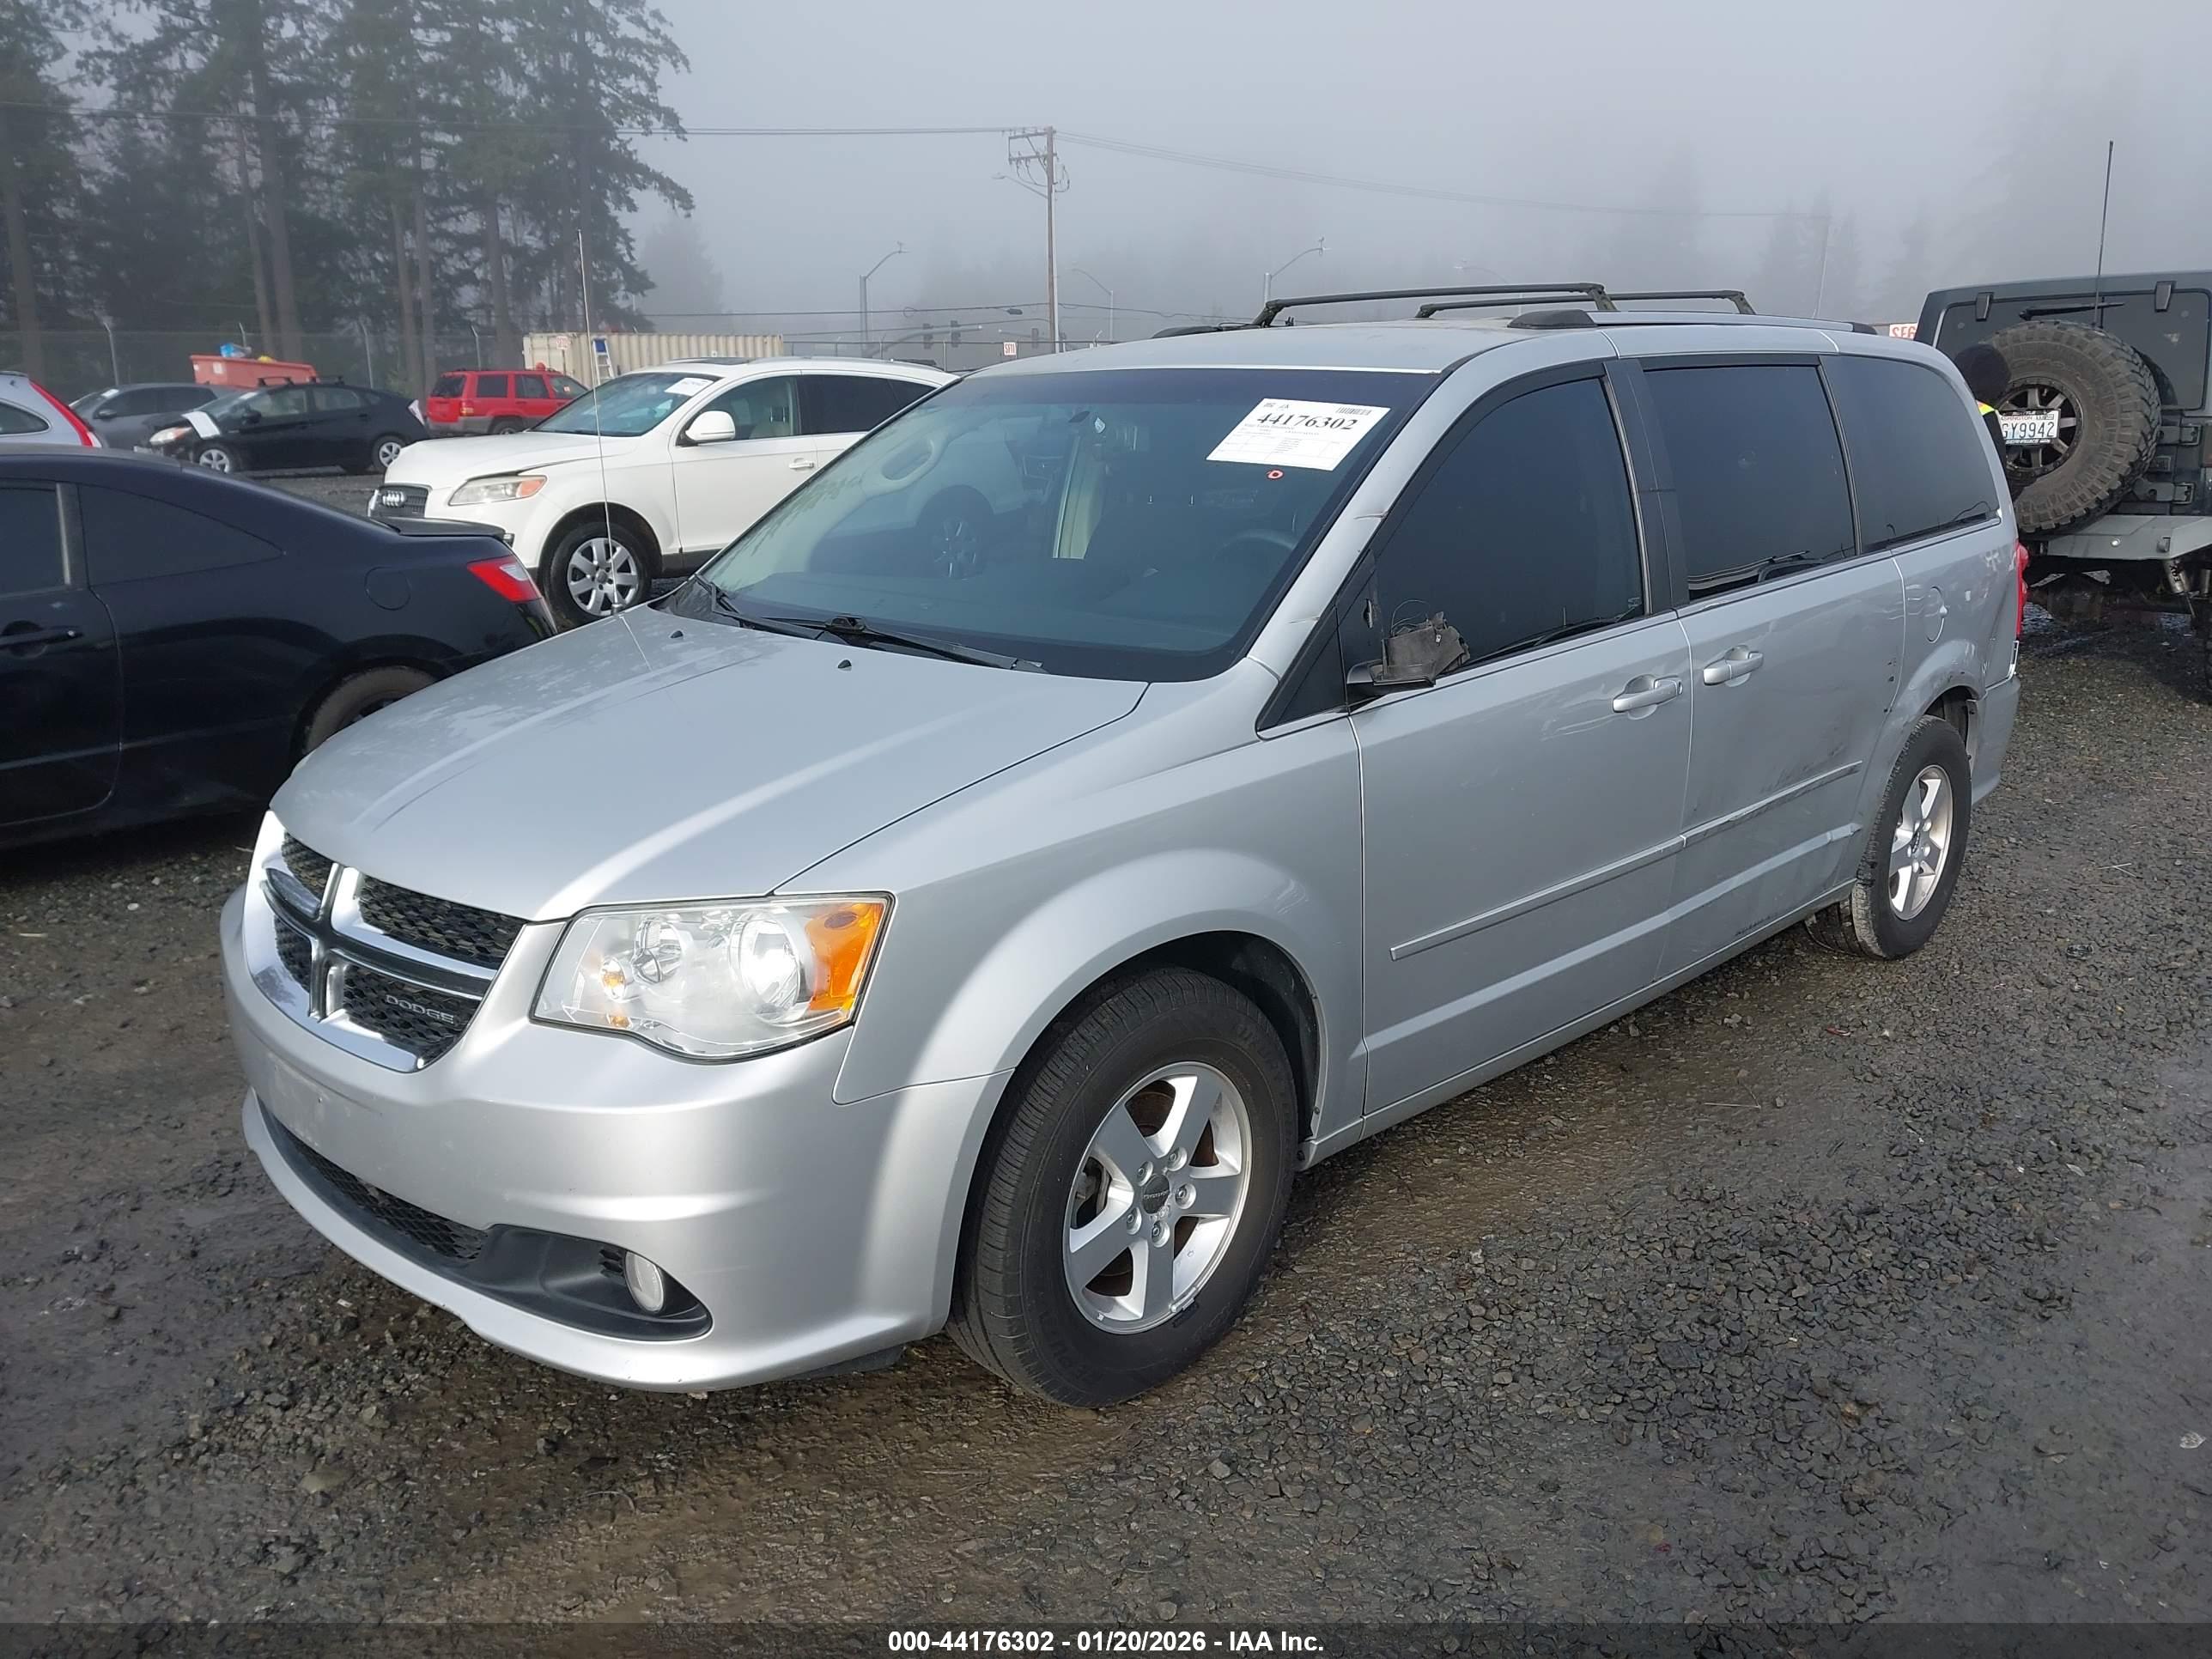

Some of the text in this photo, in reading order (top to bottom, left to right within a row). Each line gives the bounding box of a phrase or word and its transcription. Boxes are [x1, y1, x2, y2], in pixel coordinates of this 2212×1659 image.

[1257, 412, 1358, 430] 44176302
[2002, 421, 2055, 439] GY9942
[386, 994, 454, 1024] DODGE
